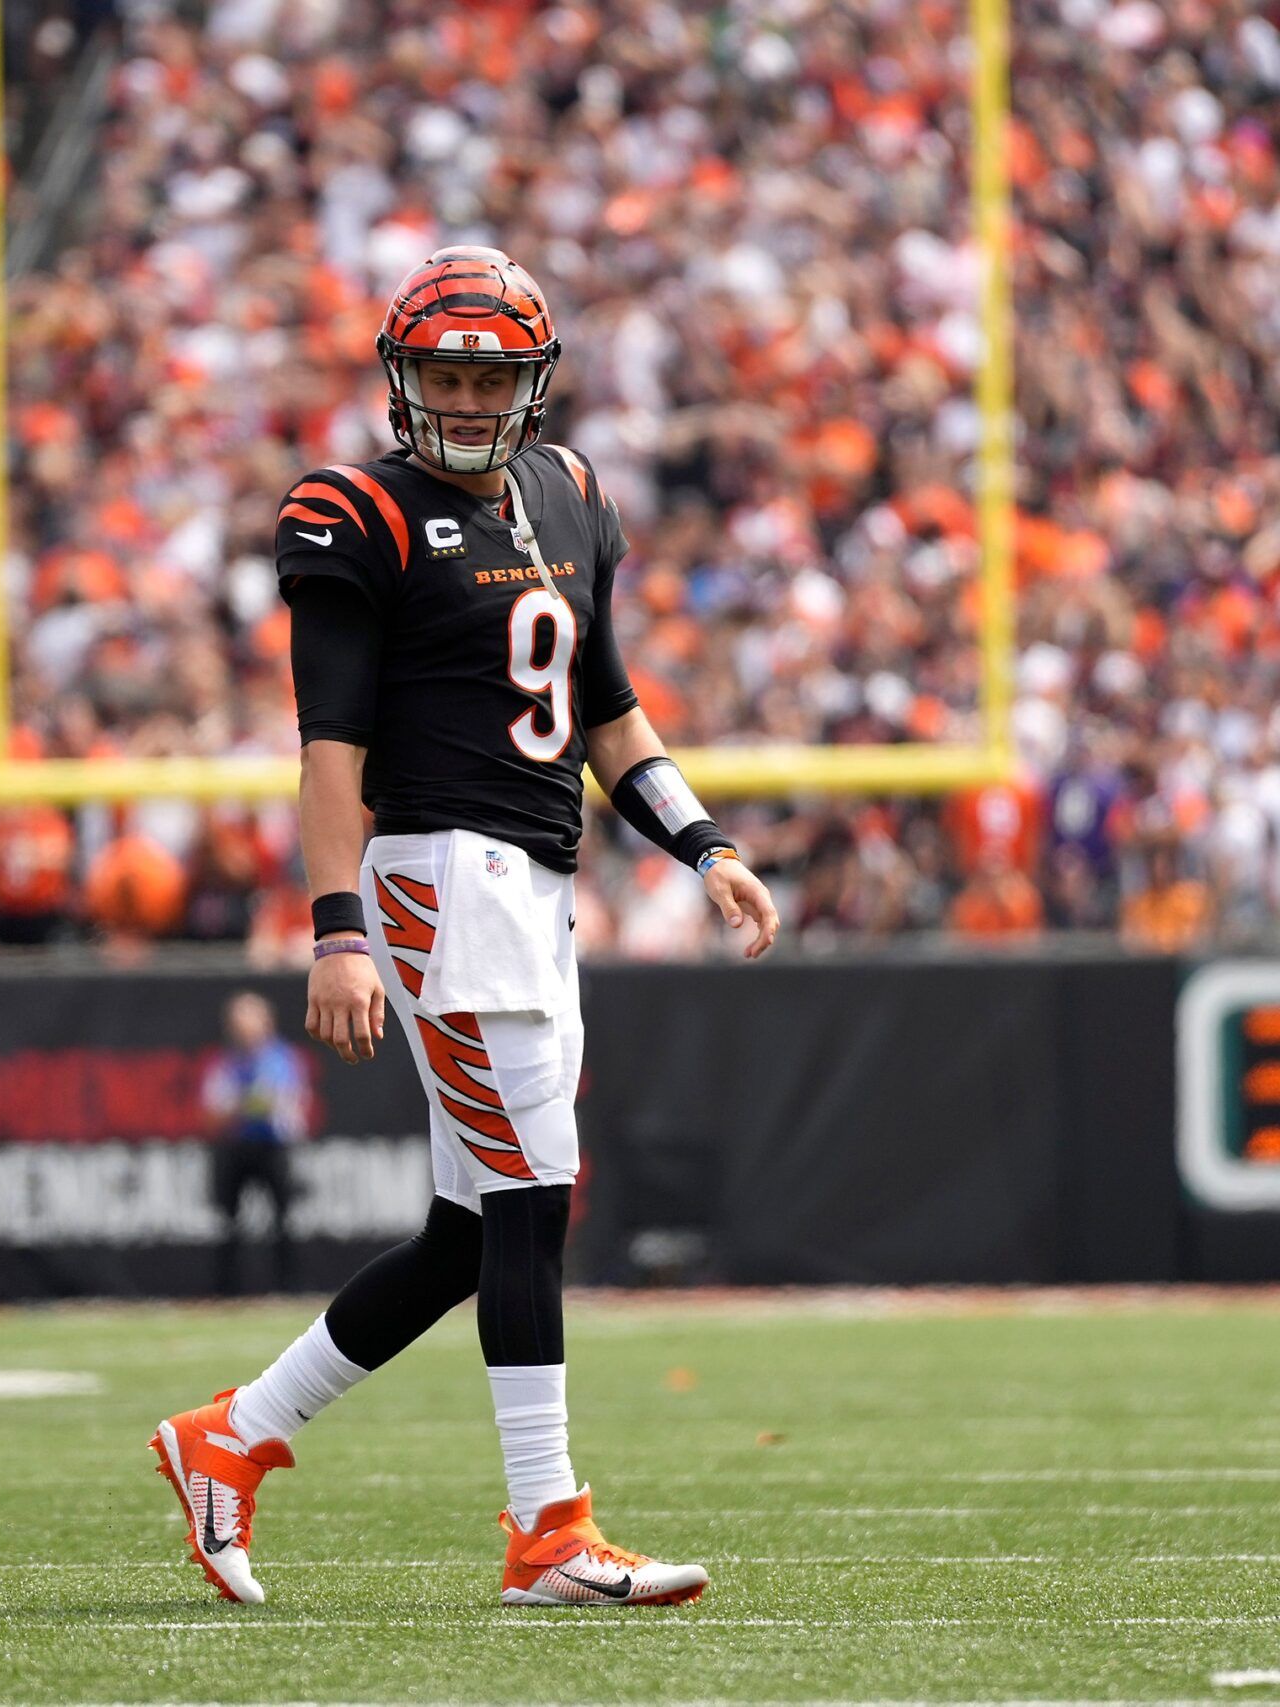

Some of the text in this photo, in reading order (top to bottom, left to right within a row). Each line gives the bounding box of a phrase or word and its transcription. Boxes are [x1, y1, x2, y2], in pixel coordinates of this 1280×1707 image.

[425, 518, 463, 548] C
[474, 561, 576, 585] BENGLS
[508, 586, 577, 762] 9
